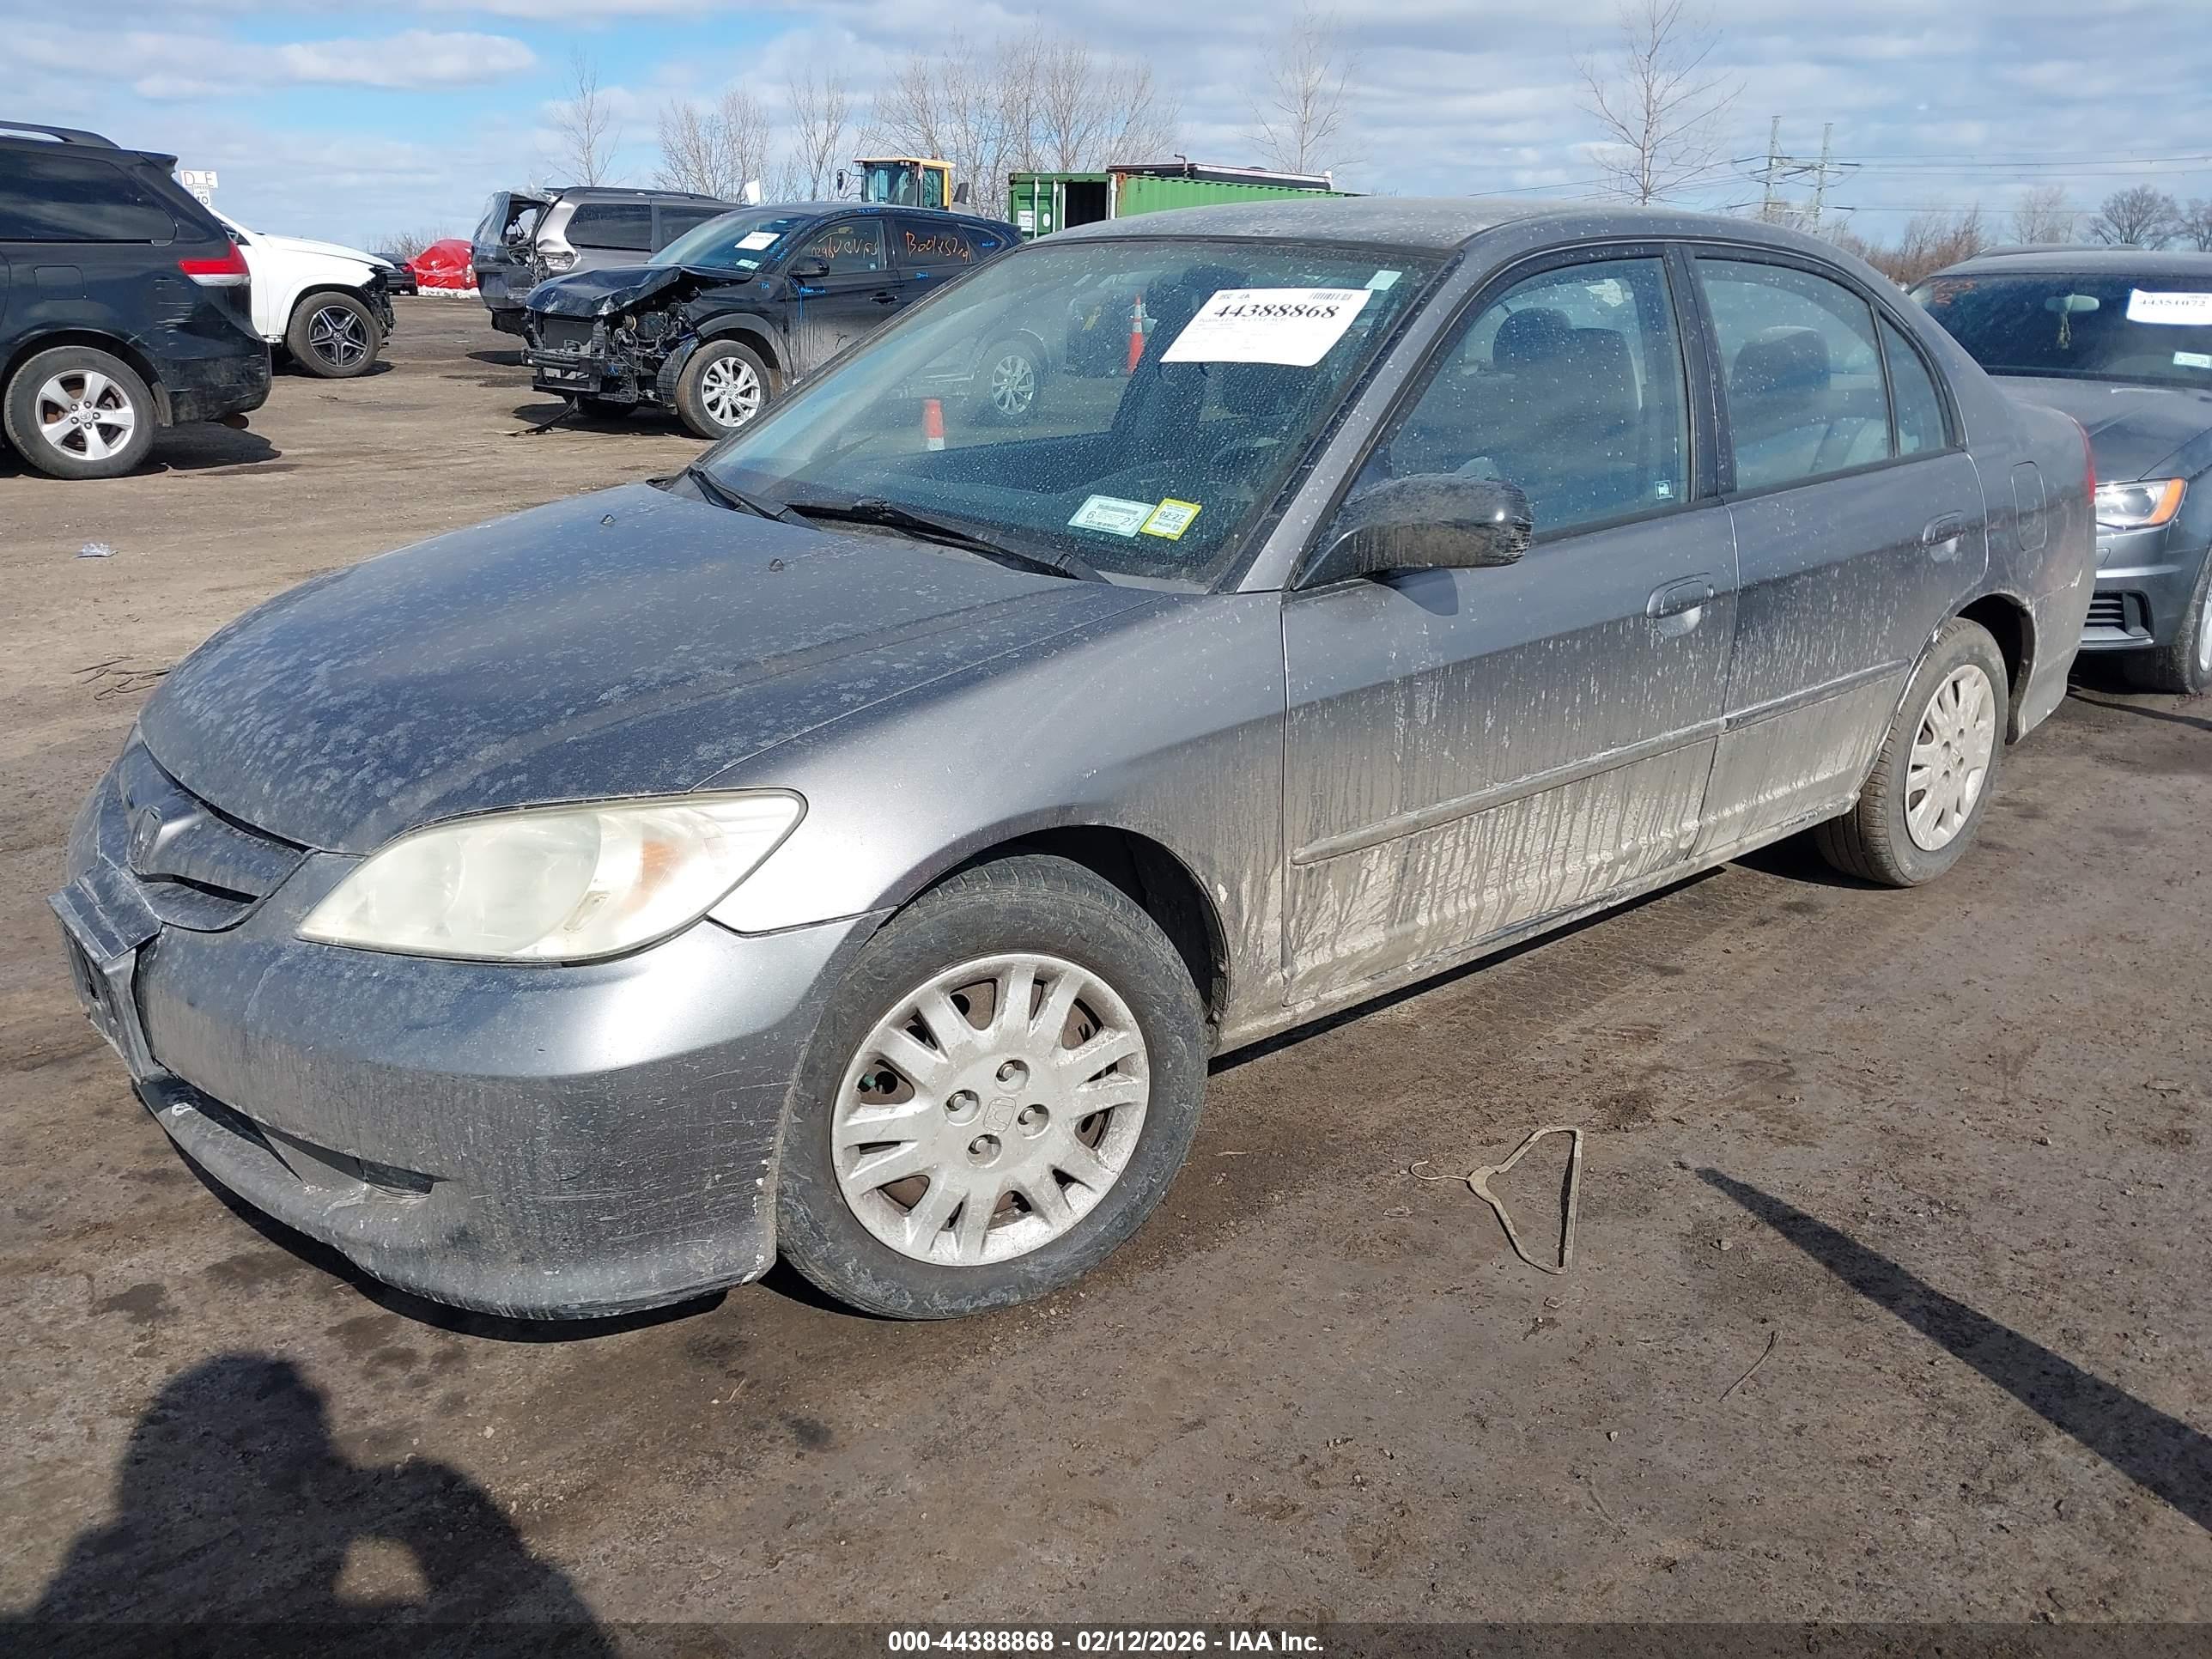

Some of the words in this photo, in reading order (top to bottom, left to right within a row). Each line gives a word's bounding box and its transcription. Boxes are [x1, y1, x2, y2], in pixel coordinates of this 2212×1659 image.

[184, 171, 195, 185] D
[1213, 303, 1340, 319] 44388868
[1086, 510, 1097, 520] 6
[1120, 516, 1139, 526] 27
